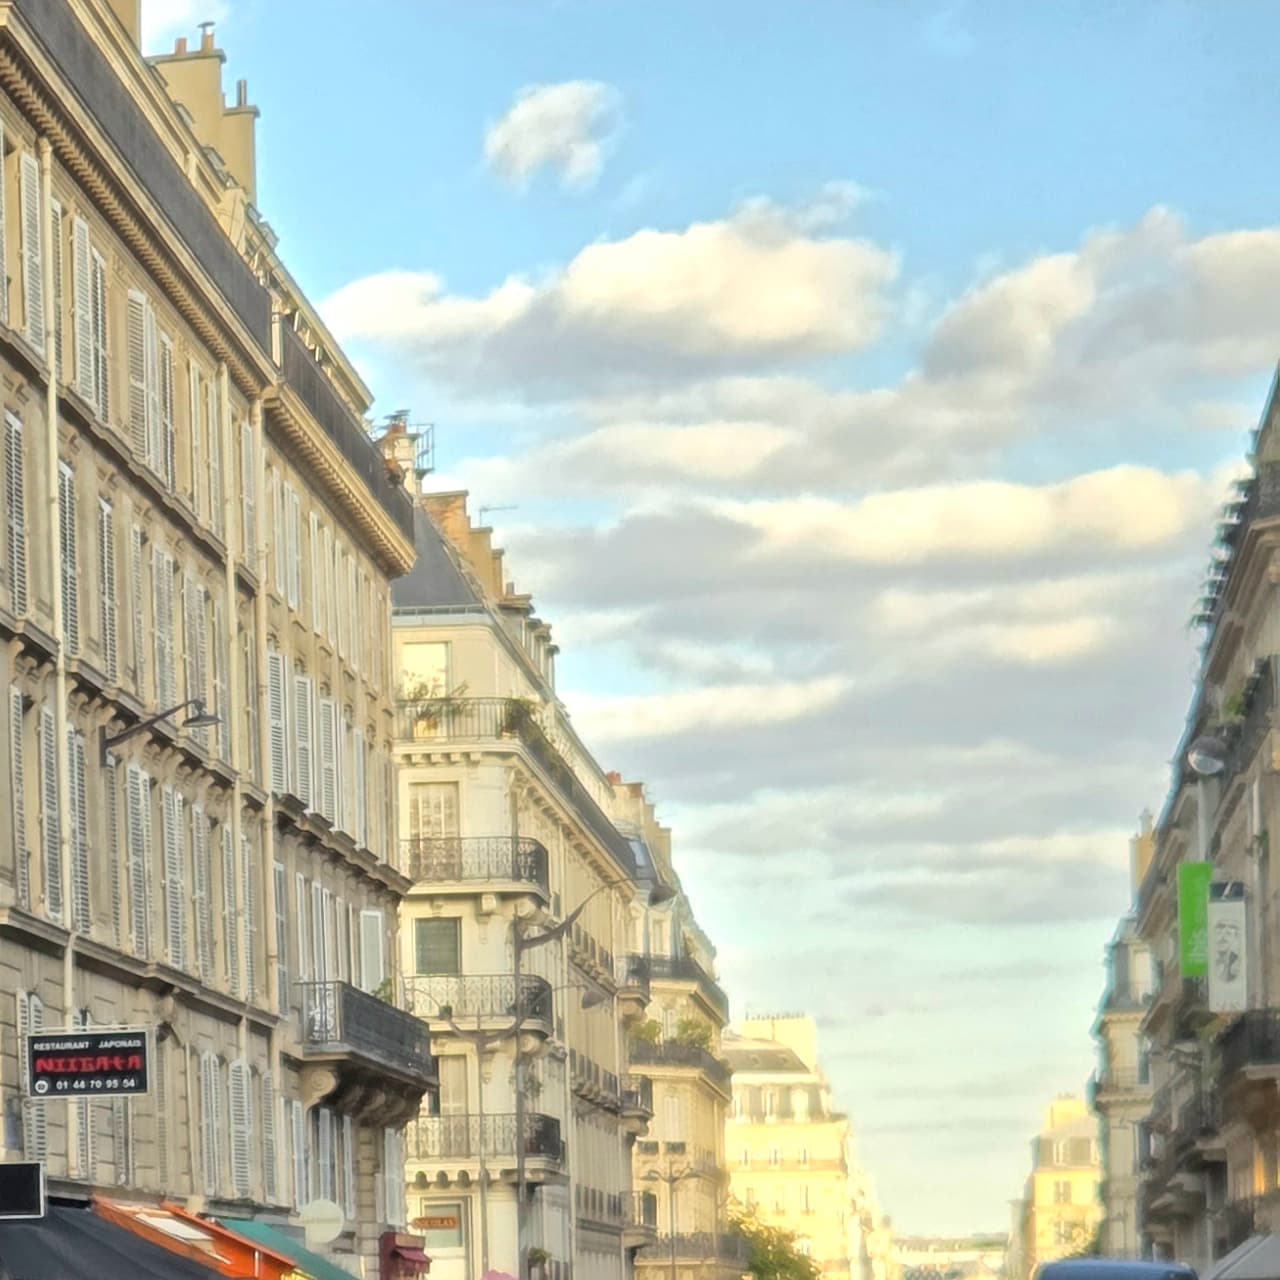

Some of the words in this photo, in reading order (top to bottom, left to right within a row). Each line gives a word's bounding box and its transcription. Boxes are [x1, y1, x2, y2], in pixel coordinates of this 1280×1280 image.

[33, 1041, 90, 1051] RESTAURANT
[98, 1039, 142, 1049] JAPONAIS
[55, 1080, 68, 1090] 01
